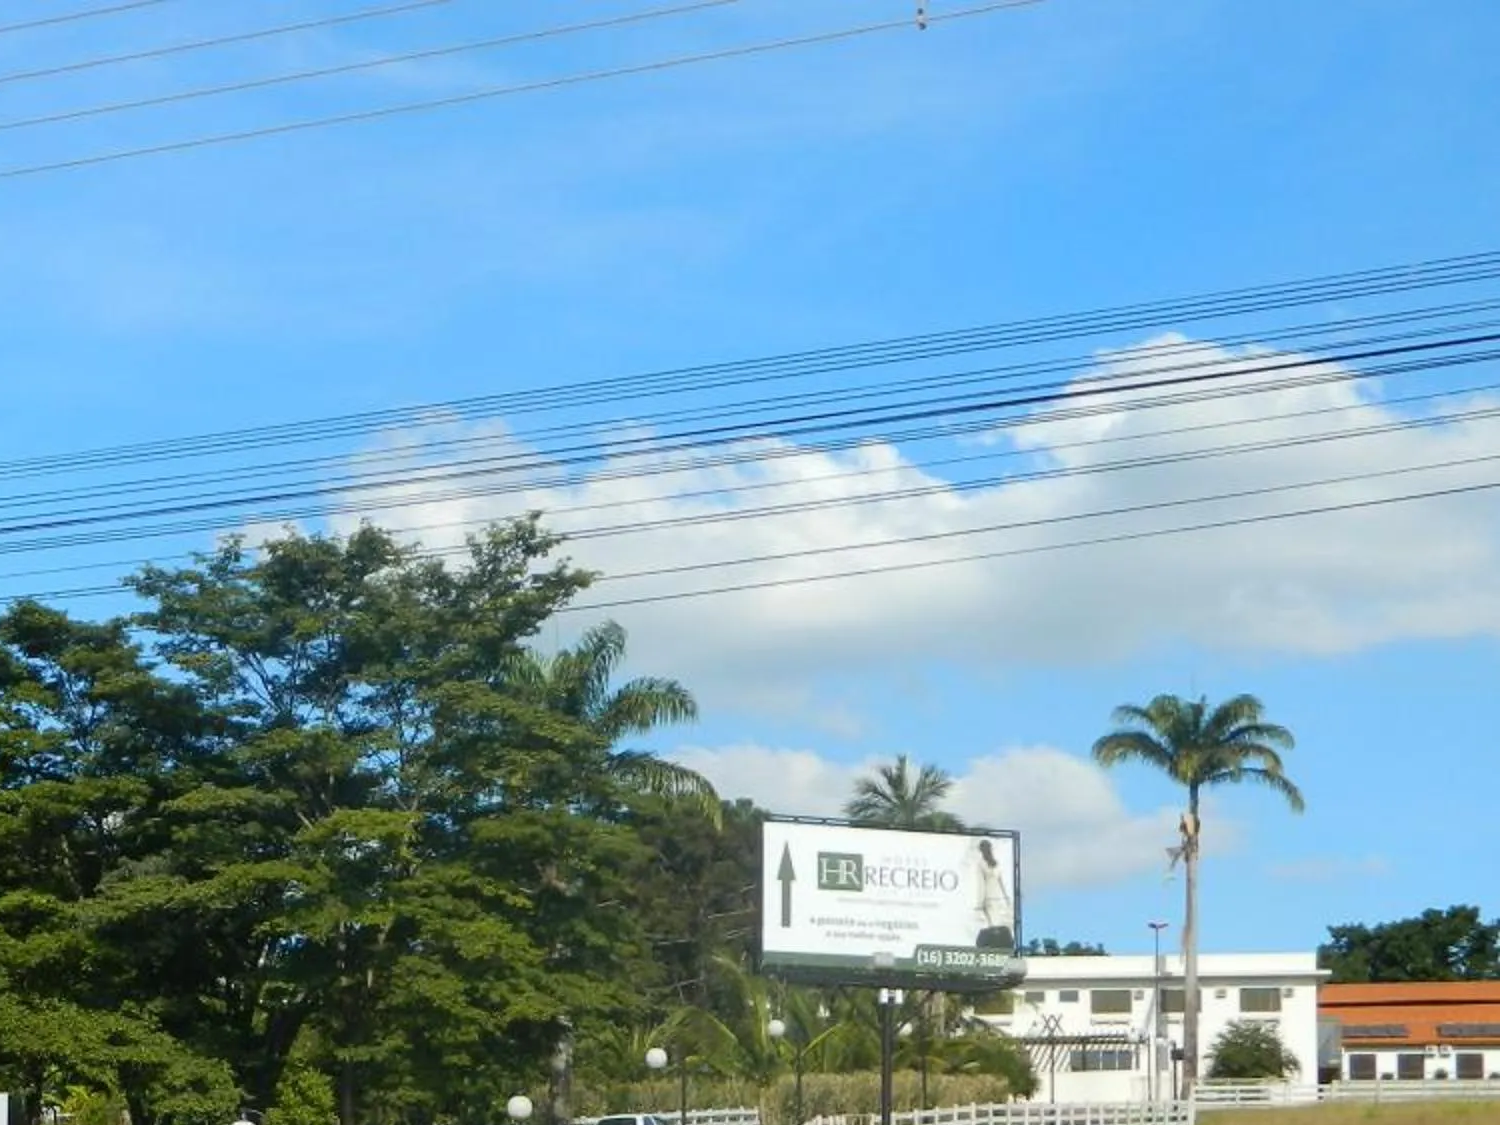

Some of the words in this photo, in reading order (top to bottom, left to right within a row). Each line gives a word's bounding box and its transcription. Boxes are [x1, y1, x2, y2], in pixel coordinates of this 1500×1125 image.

[819, 857, 862, 886] HR
[865, 864, 960, 892] RECREIO
[917, 948, 942, 967] (16)
